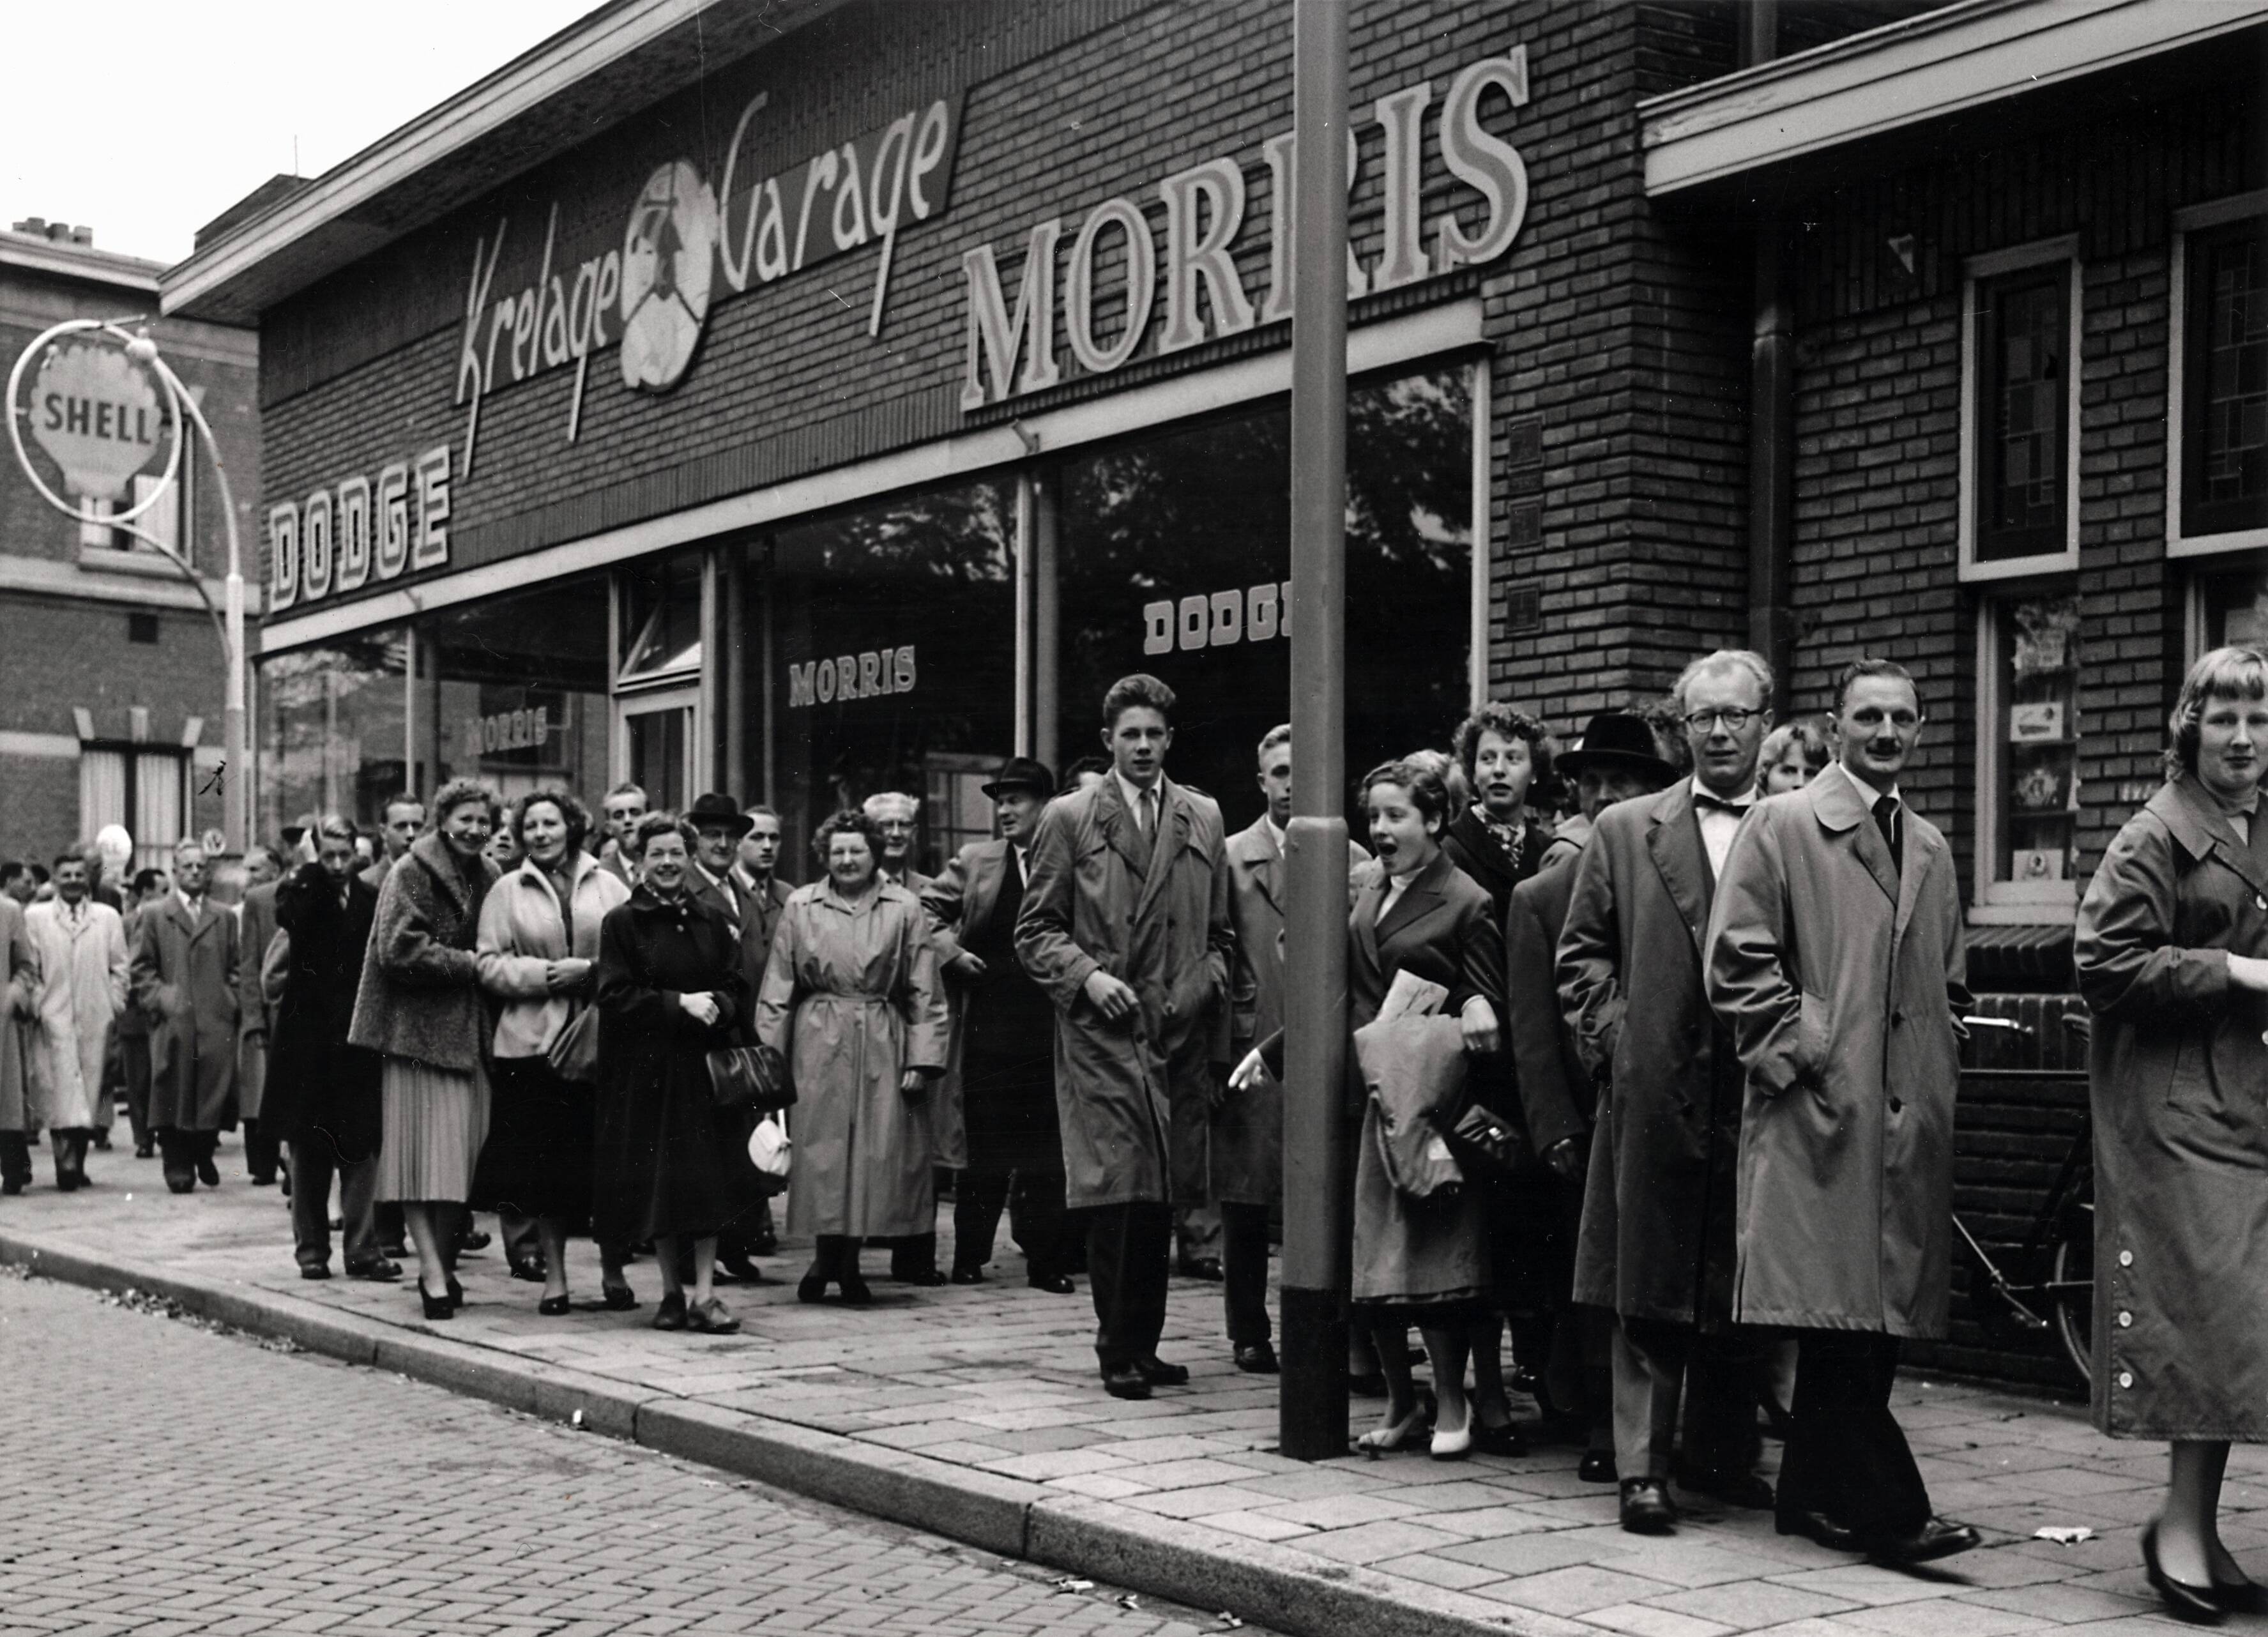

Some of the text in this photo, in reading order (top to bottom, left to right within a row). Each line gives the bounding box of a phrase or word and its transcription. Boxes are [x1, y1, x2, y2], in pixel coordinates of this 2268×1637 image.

[456, 91, 949, 478] Krelage Garage
[44, 393, 153, 445] SHELL
[269, 445, 451, 613] DODGE
[1143, 581, 1291, 656] DODG
[789, 644, 917, 708] MORRIS
[465, 706, 547, 756] MORRIS
